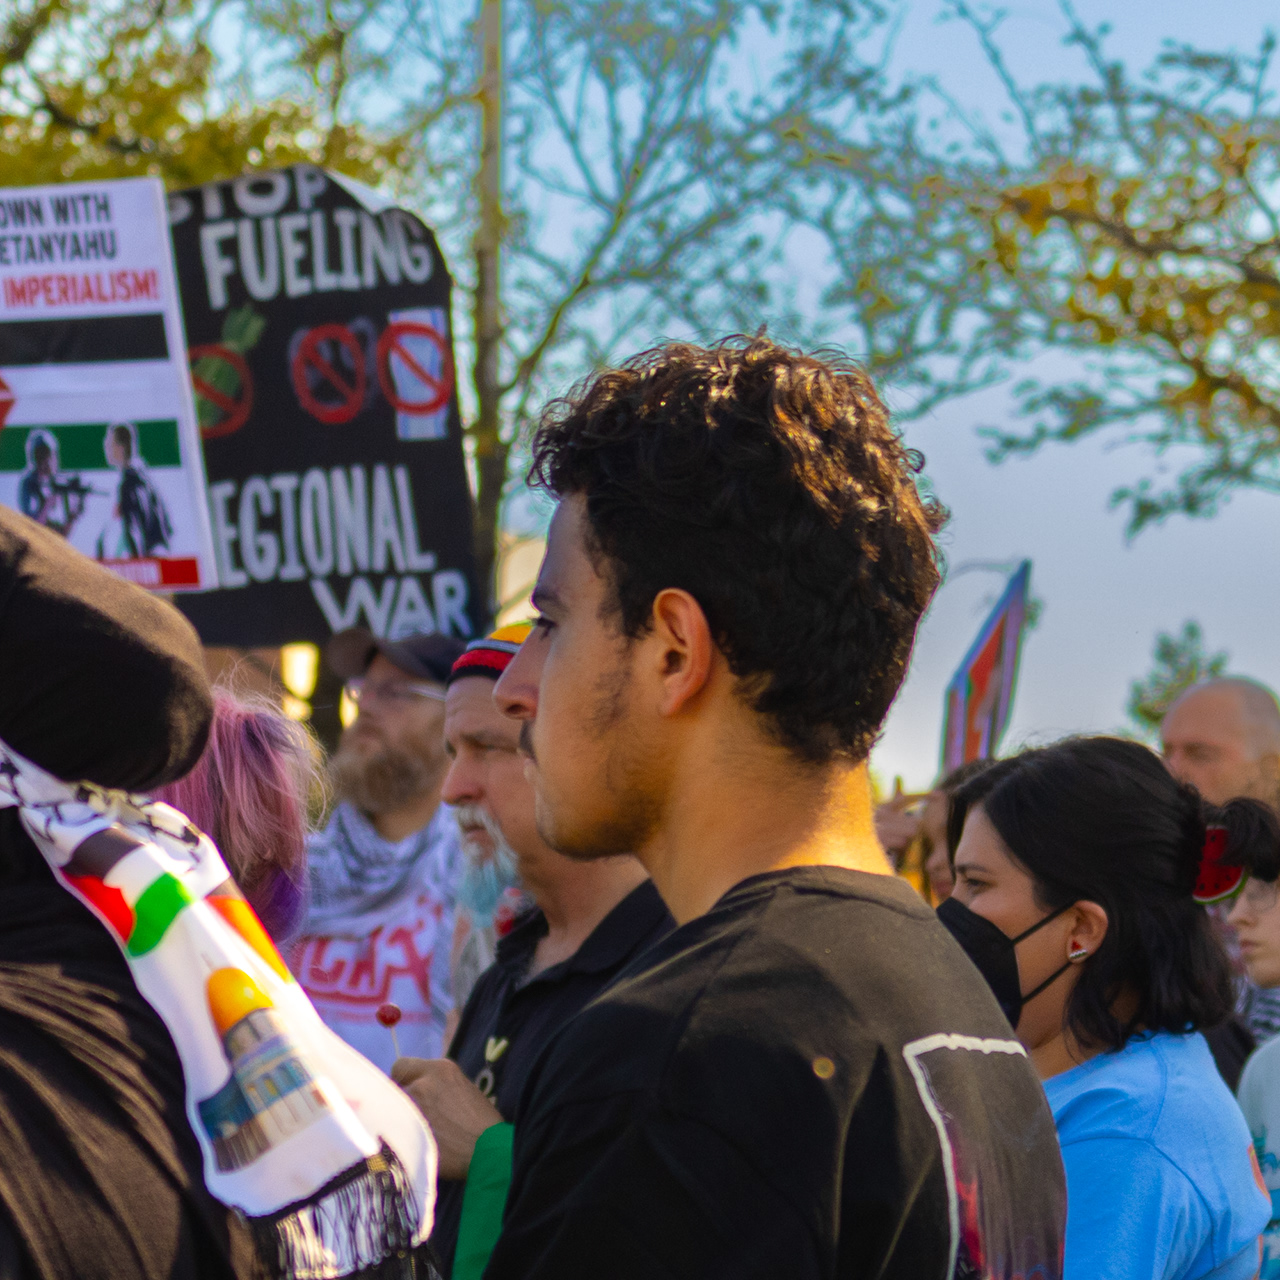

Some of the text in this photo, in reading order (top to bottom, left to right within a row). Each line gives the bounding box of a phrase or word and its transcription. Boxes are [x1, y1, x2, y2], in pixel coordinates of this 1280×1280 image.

[50, 192, 111, 225] WITH
[3, 268, 159, 309] IMPERIALISM!
[200, 206, 434, 311] FUELING
[207, 462, 438, 590] EGIONAL
[310, 569, 474, 643] WAR
